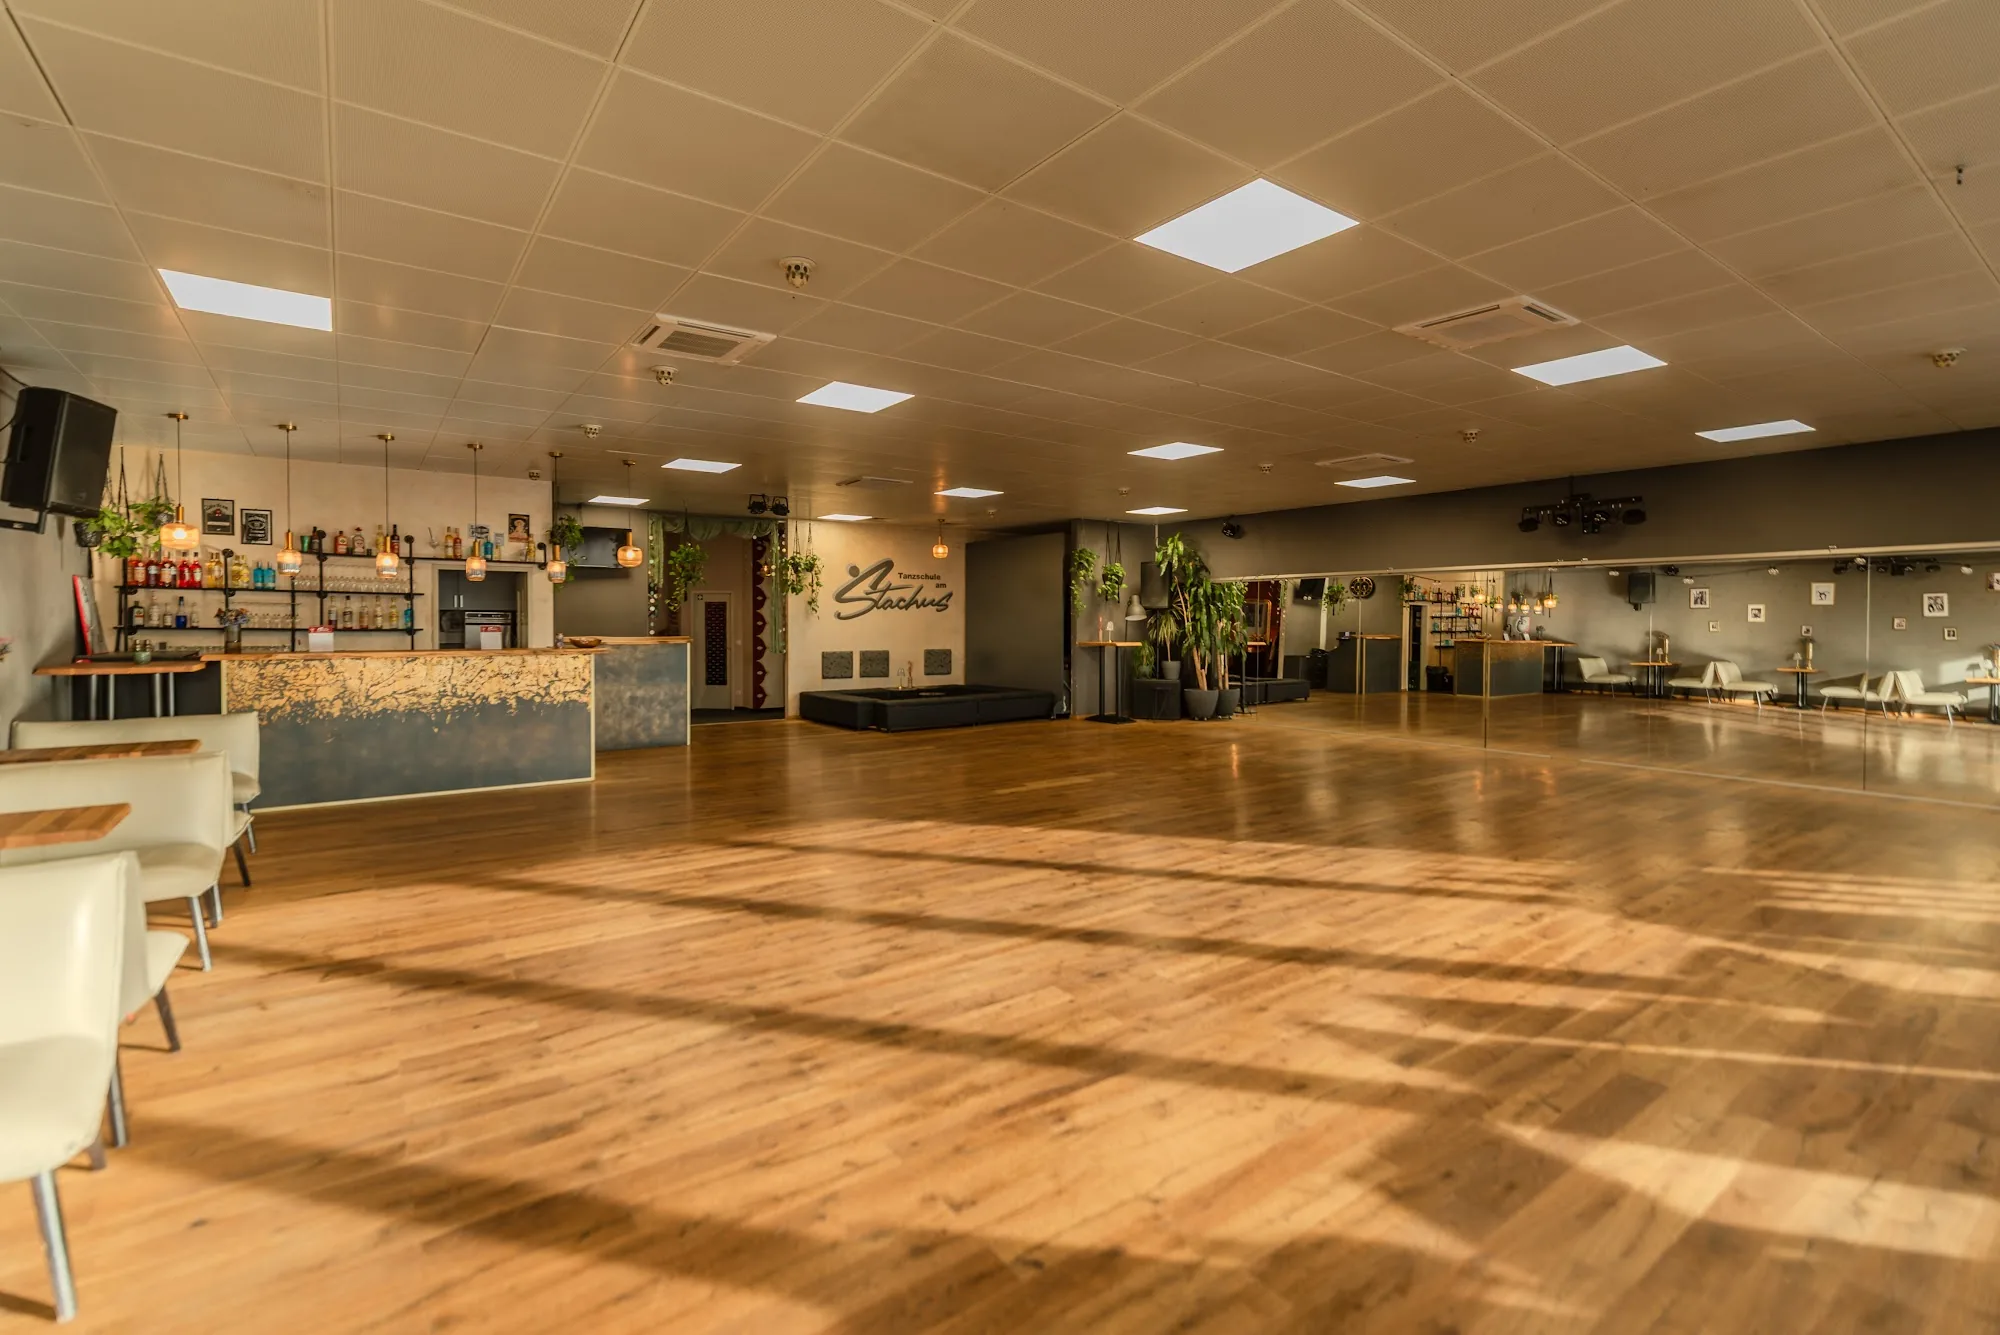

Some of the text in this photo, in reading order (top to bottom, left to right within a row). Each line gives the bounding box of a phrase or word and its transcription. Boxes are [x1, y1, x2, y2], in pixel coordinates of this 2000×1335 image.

[897, 572, 942, 581] Tanzschule
[833, 557, 954, 621] Stachus
[935, 582, 947, 590] am
